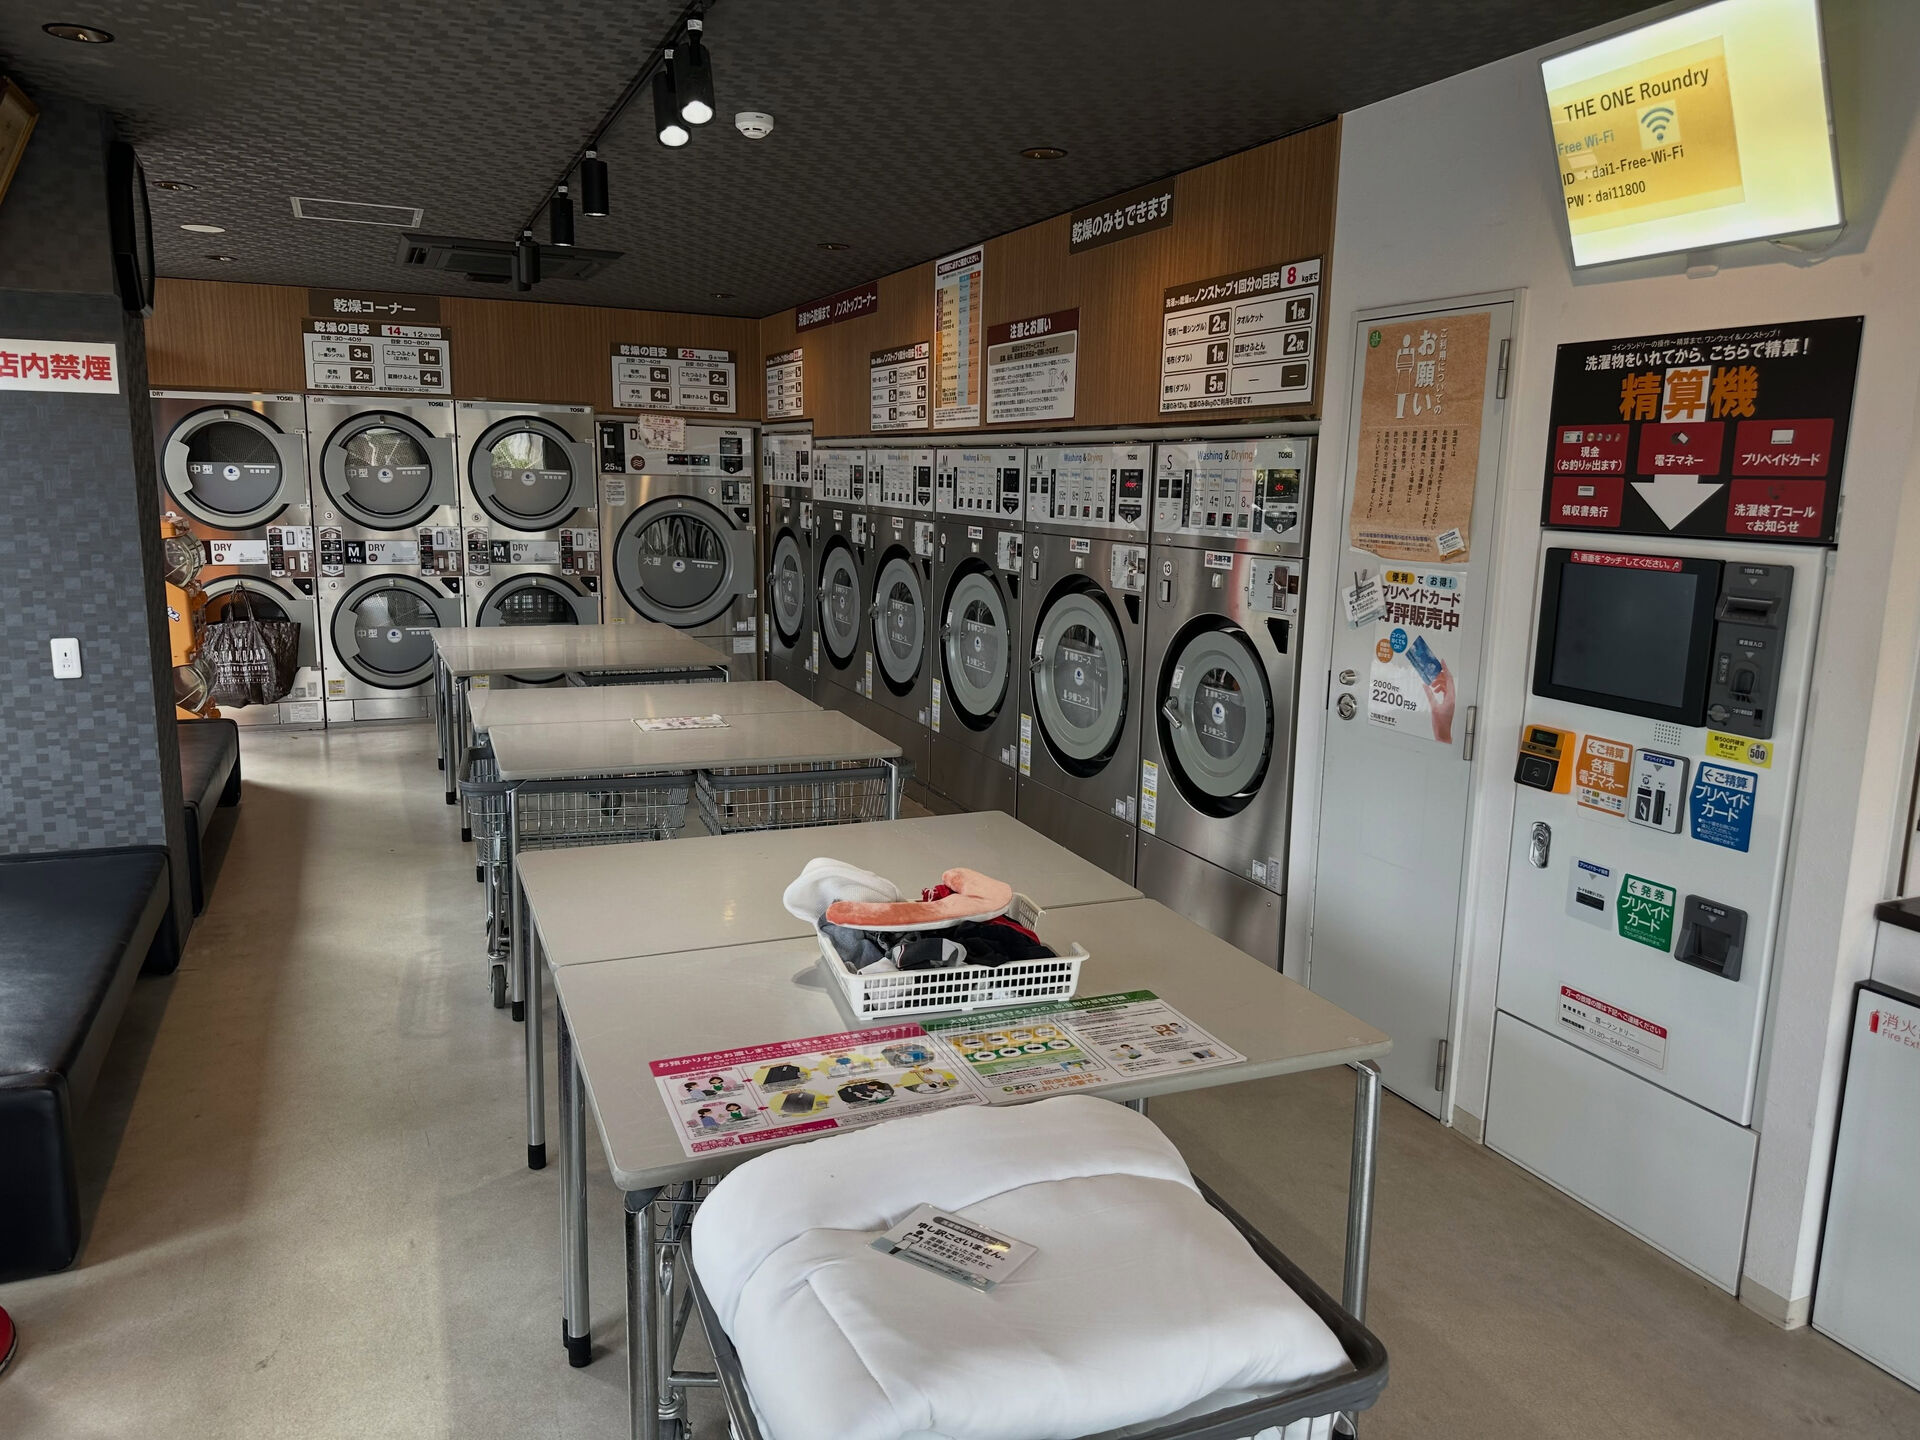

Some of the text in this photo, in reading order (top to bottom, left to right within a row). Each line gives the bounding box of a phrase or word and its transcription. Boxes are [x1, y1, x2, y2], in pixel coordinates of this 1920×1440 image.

[1563, 67, 1710, 122] THE ONE Roundry
[1557, 129, 1615, 156] Free Wi-Fi
[1562, 171, 1575, 186] ID
[1566, 193, 1585, 209] PW
[1072, 193, 1172, 245] 乾燥のみもできます
[1286, 266, 1297, 285] 8
[333, 297, 417, 315] 乾燥コーナー
[313, 321, 402, 337] 乾燥の目安 14
[1010, 318, 1052, 339] 注意とお願い
[619, 344, 695, 359] 乾燥の目安 25
[0, 352, 113, 382] 店内禁煙
[1413, 329, 1438, 416] お願い
[1433, 328, 1448, 415] ご利用についての
[1618, 364, 1760, 421] 精算機
[603, 433, 615, 449] L
[1198, 450, 1223, 463] Washing
[1224, 449, 1230, 460] &
[1230, 449, 1253, 463] Drying
[1580, 446, 1600, 458] 現金
[1654, 454, 1704, 466] 電子マネー
[190, 464, 214, 475] 中型
[1562, 504, 1609, 518] 領収書発行
[1734, 503, 1815, 518] 洗濯終了コール
[1746, 519, 1800, 533] でお知らせ
[213, 543, 232, 551] DRY
[348, 547, 360, 557] M
[368, 543, 386, 551] DRY
[493, 543, 529, 556] M DRY
[643, 556, 661, 566] 大型
[1391, 572, 1410, 584] 便利
[1377, 601, 1460, 632] 好評販売中
[1372, 688, 1417, 711] 2200円分
[1749, 749, 1765, 760] 500
[1591, 758, 1615, 776] 各種
[1579, 769, 1625, 791] 電子マネー
[1715, 772, 1749, 789] ご精算
[1695, 785, 1750, 809] プリペイド
[1701, 802, 1739, 823] カード
[1641, 884, 1665, 902] 発券
[1621, 894, 1670, 921] プリペイド
[1626, 912, 1661, 933] カード
[1882, 1011, 1920, 1039] 消火
[1882, 1029, 1901, 1042] Fire
